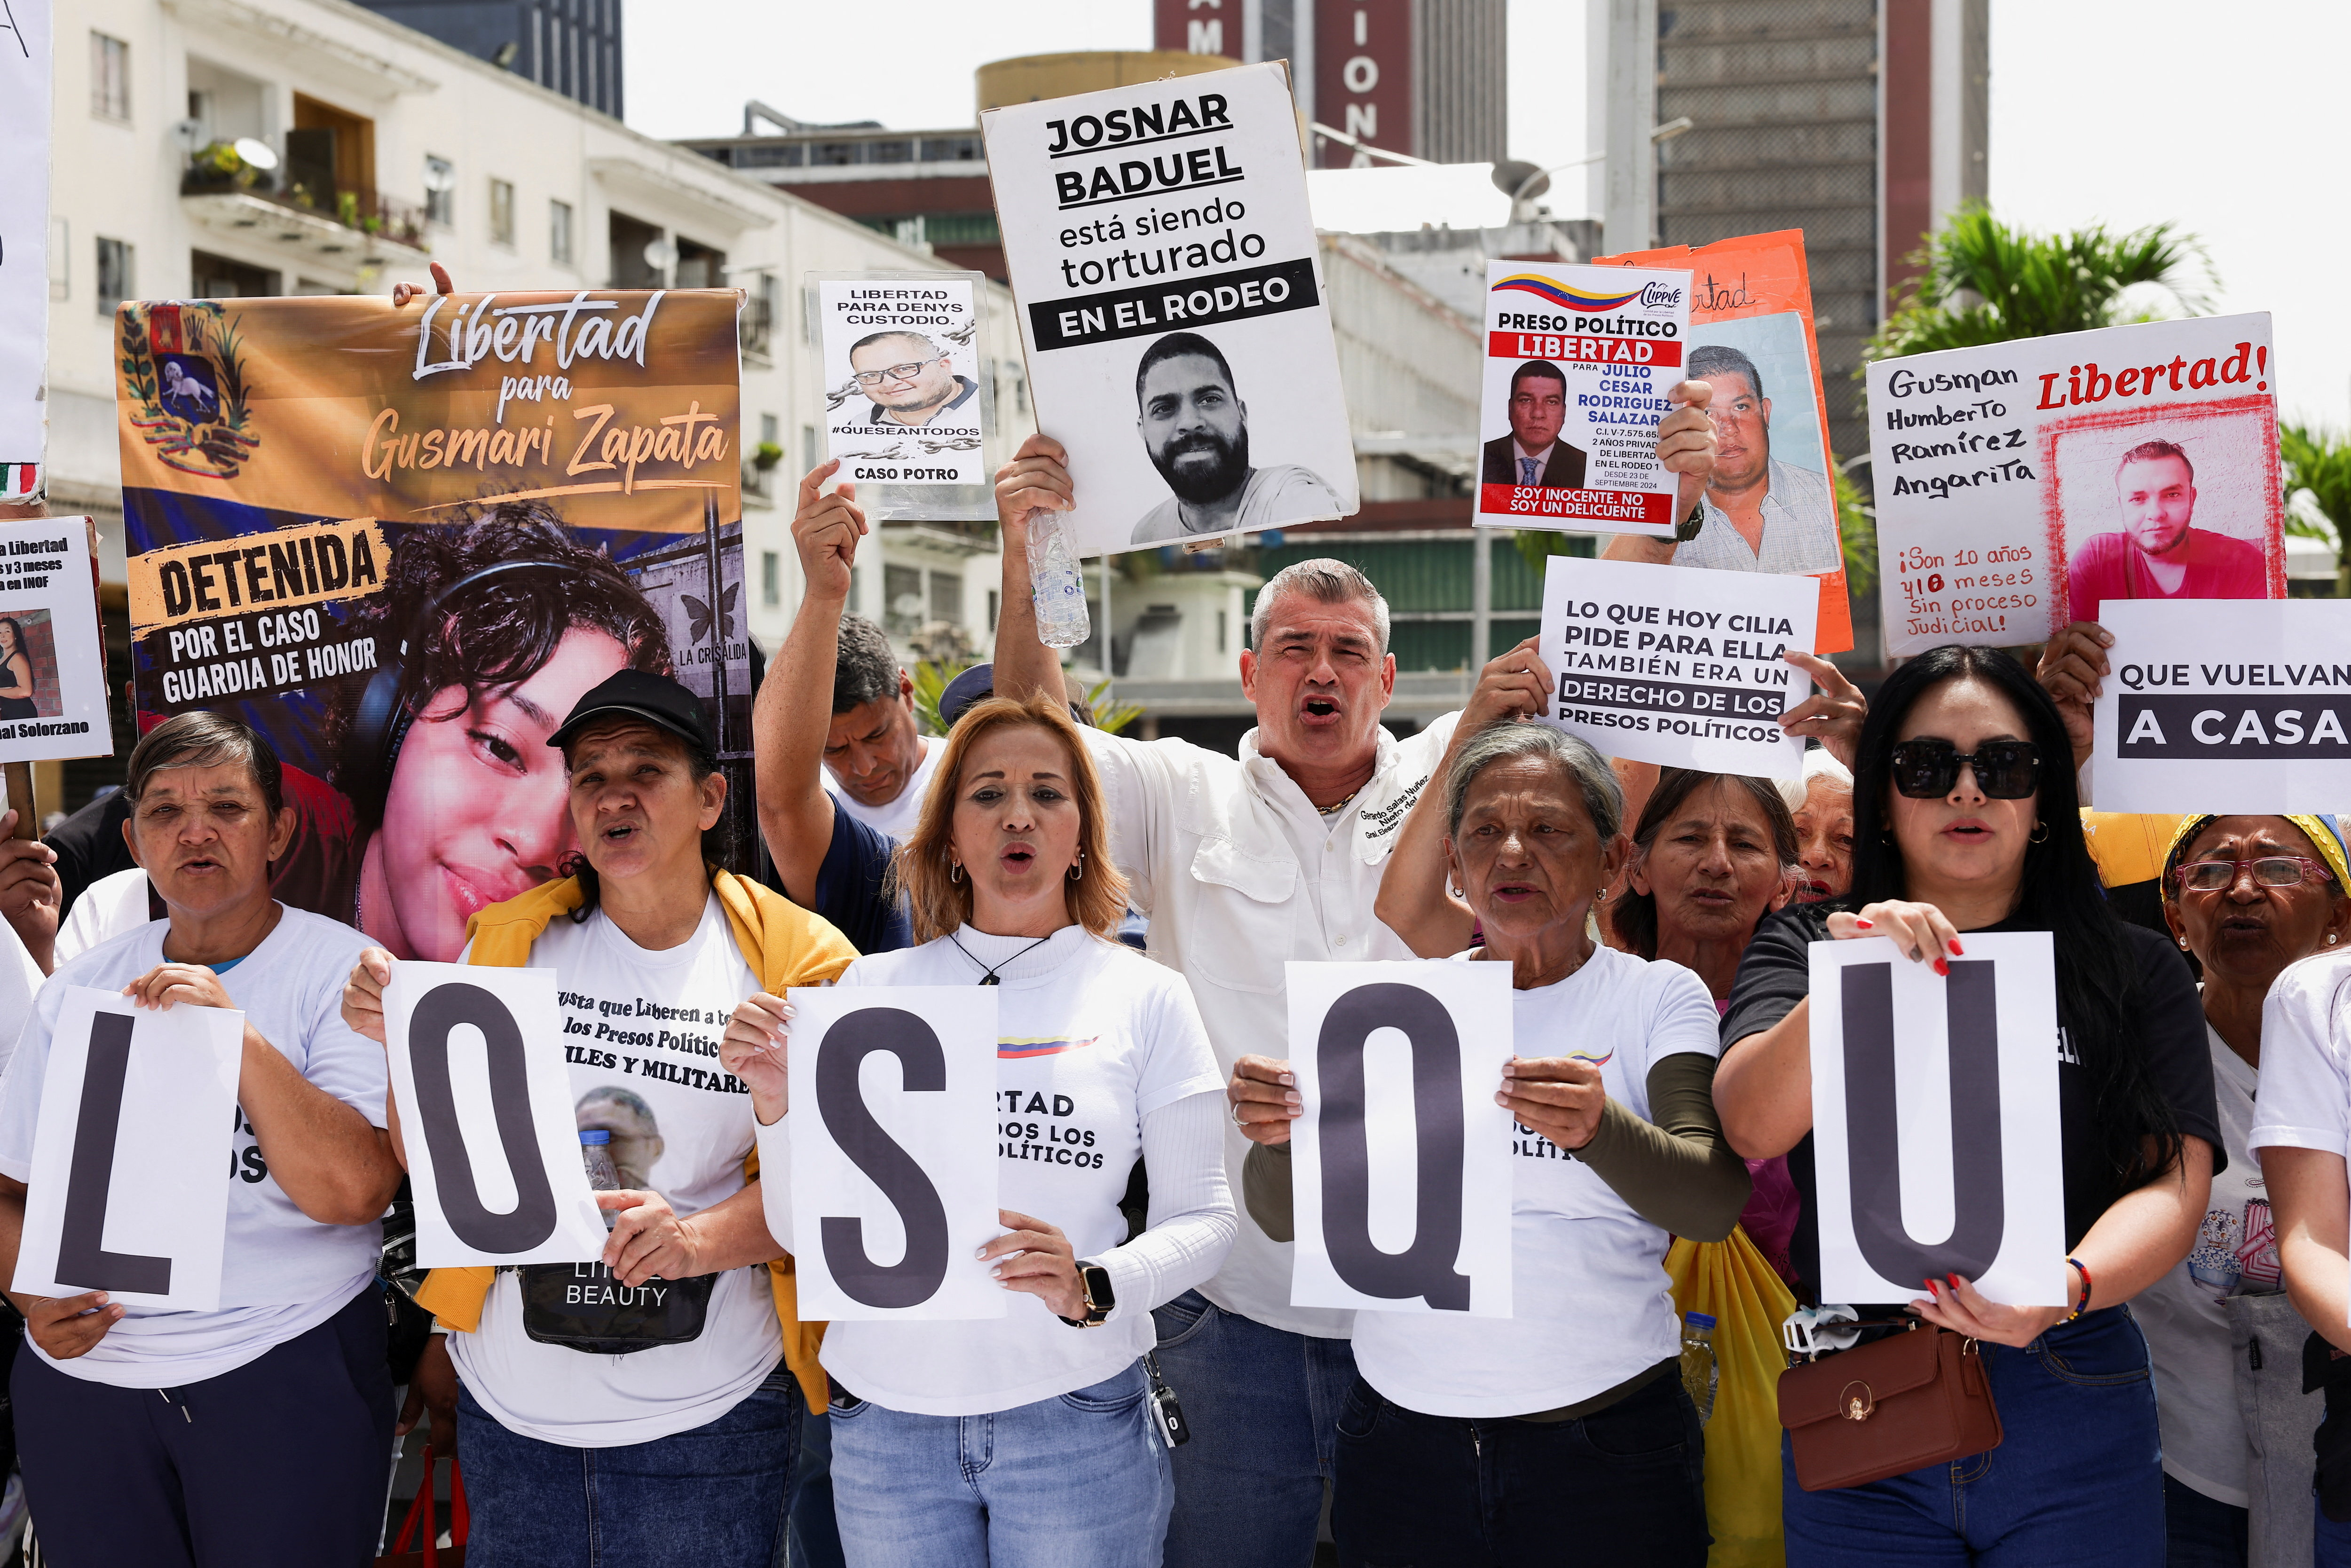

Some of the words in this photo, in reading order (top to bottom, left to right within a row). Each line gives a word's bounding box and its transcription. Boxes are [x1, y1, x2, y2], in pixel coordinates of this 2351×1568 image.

[1046, 93, 1233, 153] JOSNAR
[1055, 146, 1243, 205] BADUEL
[1060, 214, 1125, 247] está
[1135, 197, 1245, 236] siendo
[1061, 229, 1266, 289] torturado
[838, 303, 891, 312] PARA
[897, 303, 963, 312] DENYS
[851, 290, 947, 299] LIBERTAD
[1058, 306, 1105, 338] EN
[1114, 299, 1156, 329] EL
[1164, 277, 1290, 321] RODEO
[847, 315, 954, 325] CUSTODIO.
[1499, 313, 1567, 331] PRESO
[1575, 315, 1678, 337] POLÍTICO
[412, 291, 667, 380] Libertad
[1518, 335, 1653, 362] LIBERTAD
[1602, 364, 1651, 378] JULIO
[1889, 369, 2018, 398] Gusman
[2036, 342, 2267, 410] Libertad!
[496, 374, 574, 424] para
[1599, 380, 1652, 394] CESAR
[1578, 395, 1673, 411] RODRIGUEZ
[832, 426, 979, 436] #QUESEANTODOS
[1588, 411, 1660, 426] SALAZAR
[1599, 437, 1624, 447] AÑOS
[1611, 429, 1659, 438] V-7.575.65
[362, 408, 553, 483] Gusmari
[566, 401, 730, 495] Zapata
[1614, 450, 1656, 459] LIBERTAD
[855, 468, 898, 479] CASO
[904, 468, 958, 480] POTRO
[1622, 461, 1650, 470] RODEO
[1514, 487, 1543, 500] SOY
[1546, 489, 1617, 504] INOCENTE.
[1622, 494, 1643, 505] NO
[1595, 480, 1638, 488] SEPTIEMBRE
[1510, 499, 1539, 512] SOY
[1542, 502, 1562, 513] UN
[1566, 503, 1645, 519] DELICUENTE
[8, 537, 68, 555] Libertad
[5, 564, 12, 575] y
[14, 561, 21, 573] 3
[24, 560, 62, 572] meses
[1900, 546, 1944, 573] ¡Son
[1955, 550, 1978, 566] 10
[1988, 546, 2032, 563] años
[7, 580, 21, 590] en
[23, 576, 48, 589] INOF
[159, 530, 377, 617] DETENIDA
[1954, 569, 2033, 589] meses
[1567, 600, 1599, 618] LO
[1607, 604, 1660, 625] QUE
[1668, 609, 1722, 629] HOY
[1728, 615, 1793, 636] CILIA
[1952, 594, 2037, 618] proceso
[169, 625, 218, 663] POR
[223, 620, 253, 653] EL
[257, 608, 320, 648] CASO
[1566, 625, 1630, 648] PIDE
[1638, 632, 1713, 656] PARA
[1723, 639, 1786, 662] ELLA
[679, 649, 693, 666] LA
[698, 641, 747, 664] CRISÁLIDA
[162, 658, 268, 703] GUARDIA
[270, 651, 302, 686] DE
[307, 637, 377, 680] HONOR
[1564, 651, 1680, 677] TAMBIÉN
[1693, 663, 1742, 682] ERA
[1755, 668, 1789, 686] UN
[2120, 664, 2190, 690] QUE
[2201, 664, 2351, 686] VUELVAN
[1563, 680, 1685, 707] DERECHO
[1692, 692, 1727, 710] DE
[1734, 694, 1781, 715] LOS
[18, 722, 89, 738] Solorzano
[1559, 707, 1649, 731] PRESOS
[1657, 718, 1780, 743] POLÍTICOS
[2125, 709, 2167, 744] A
[2191, 709, 2349, 745] CASA
[1361, 811, 1387, 820] Gerardo
[1386, 795, 1407, 812] Salas
[1404, 775, 1430, 796] Nuñez
[1378, 820, 1399, 835] Eleazar
[1379, 809, 1403, 827] Nieto
[599, 1000, 631, 1016] que
[636, 998, 700, 1022] Liberen
[705, 1012, 713, 1024] a
[563, 1016, 592, 1036] los
[594, 1022, 654, 1047] Presos
[564, 1045, 617, 1069] ILES
[623, 1056, 639, 1073] Y
[642, 1059, 751, 1095] MILITARE
[410, 983, 557, 1254] O
[1841, 960, 2004, 1291] U
[999, 1122, 1039, 1139] OS
[1050, 1126, 1095, 1147] LOS
[1317, 982, 1470, 1312] Q
[54, 1011, 172, 1295] L
[816, 1007, 948, 1309] S
[567, 1285, 667, 1307] BEAUTY
